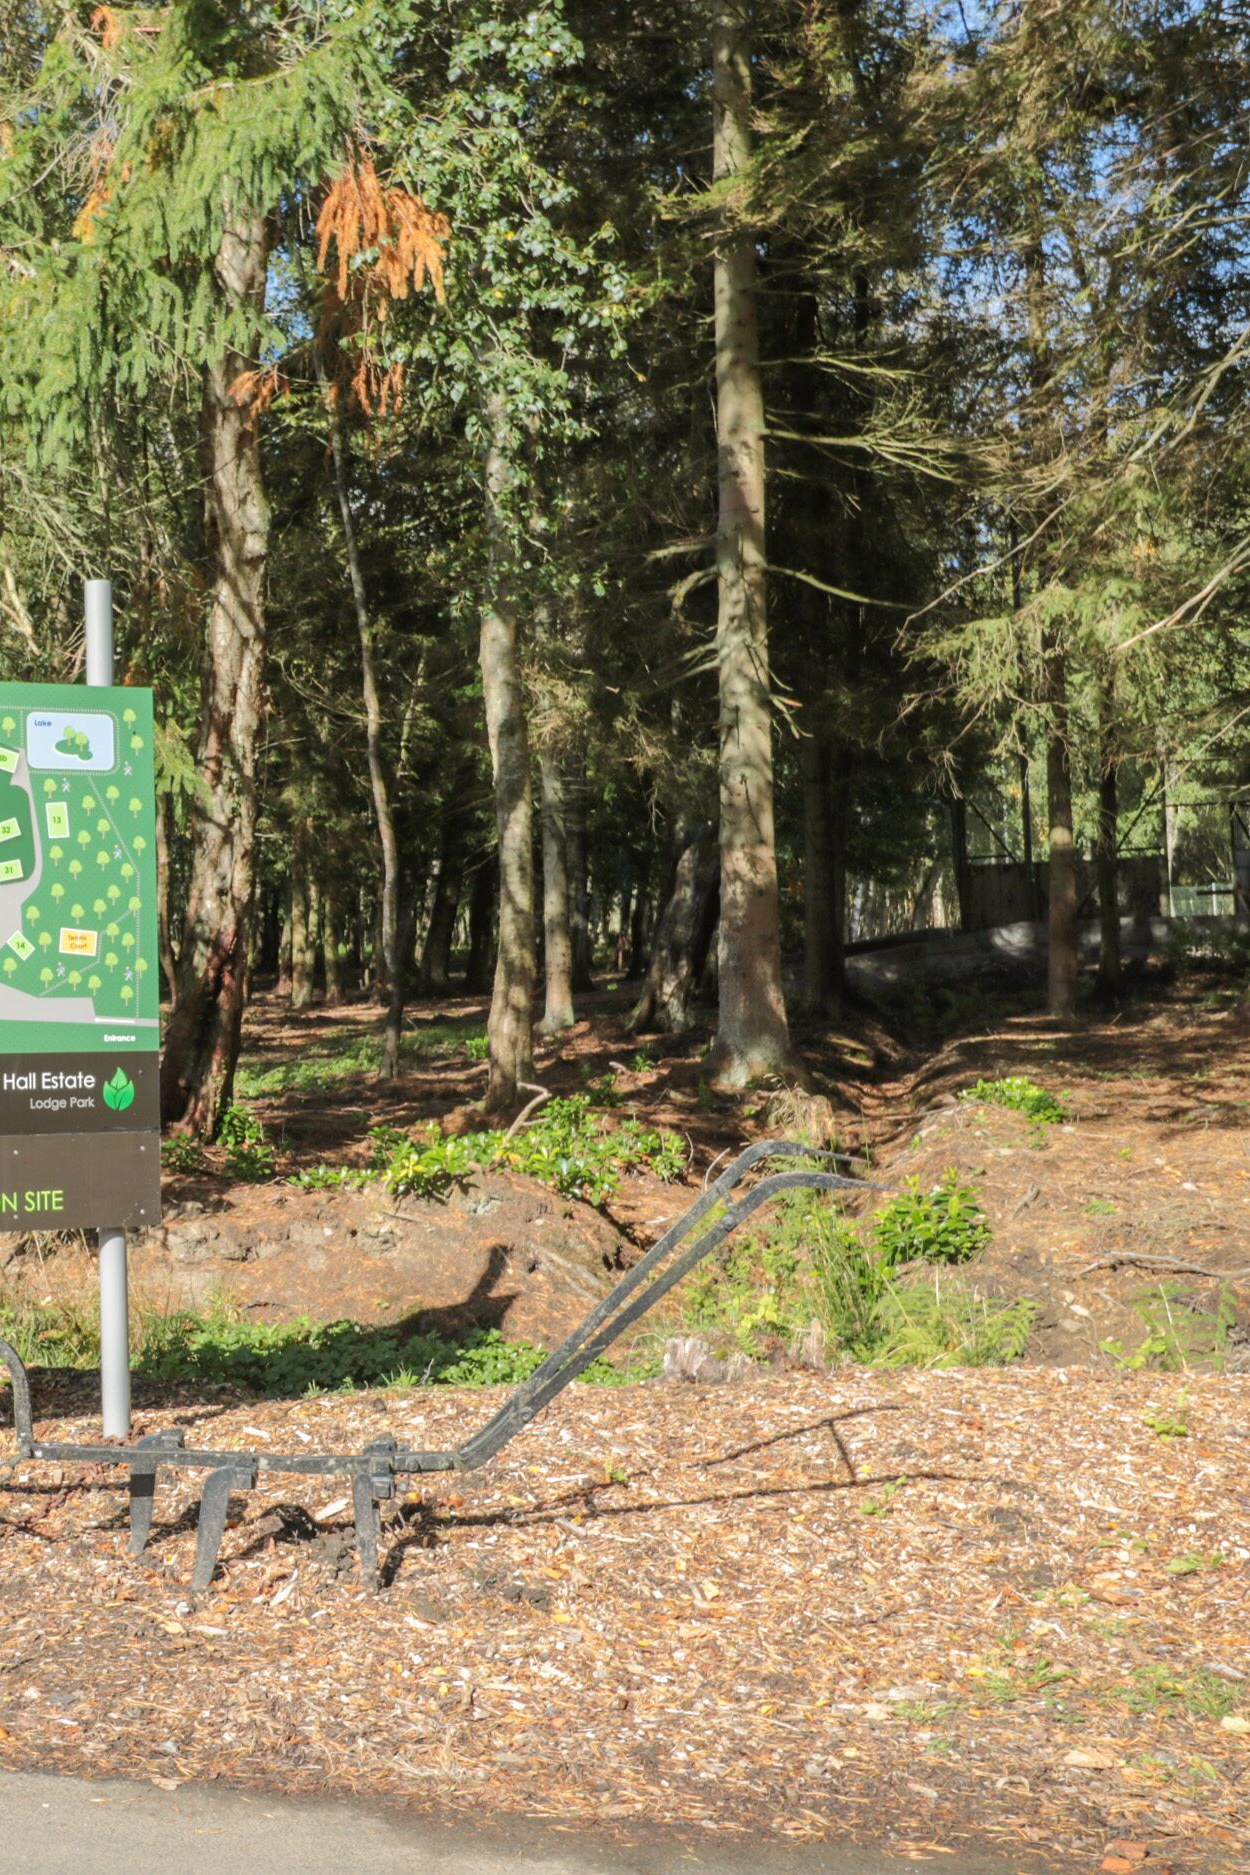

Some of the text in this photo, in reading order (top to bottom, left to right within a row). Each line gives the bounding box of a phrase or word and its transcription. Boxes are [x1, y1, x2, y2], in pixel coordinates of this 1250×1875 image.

[53, 816, 61, 824] 13
[104, 1034, 136, 1042] Entrance
[3, 1073, 36, 1090] Hall
[41, 1072, 96, 1089] Estate
[30, 1097, 95, 1111] Lodge Park
[24, 1190, 63, 1211] SITE
